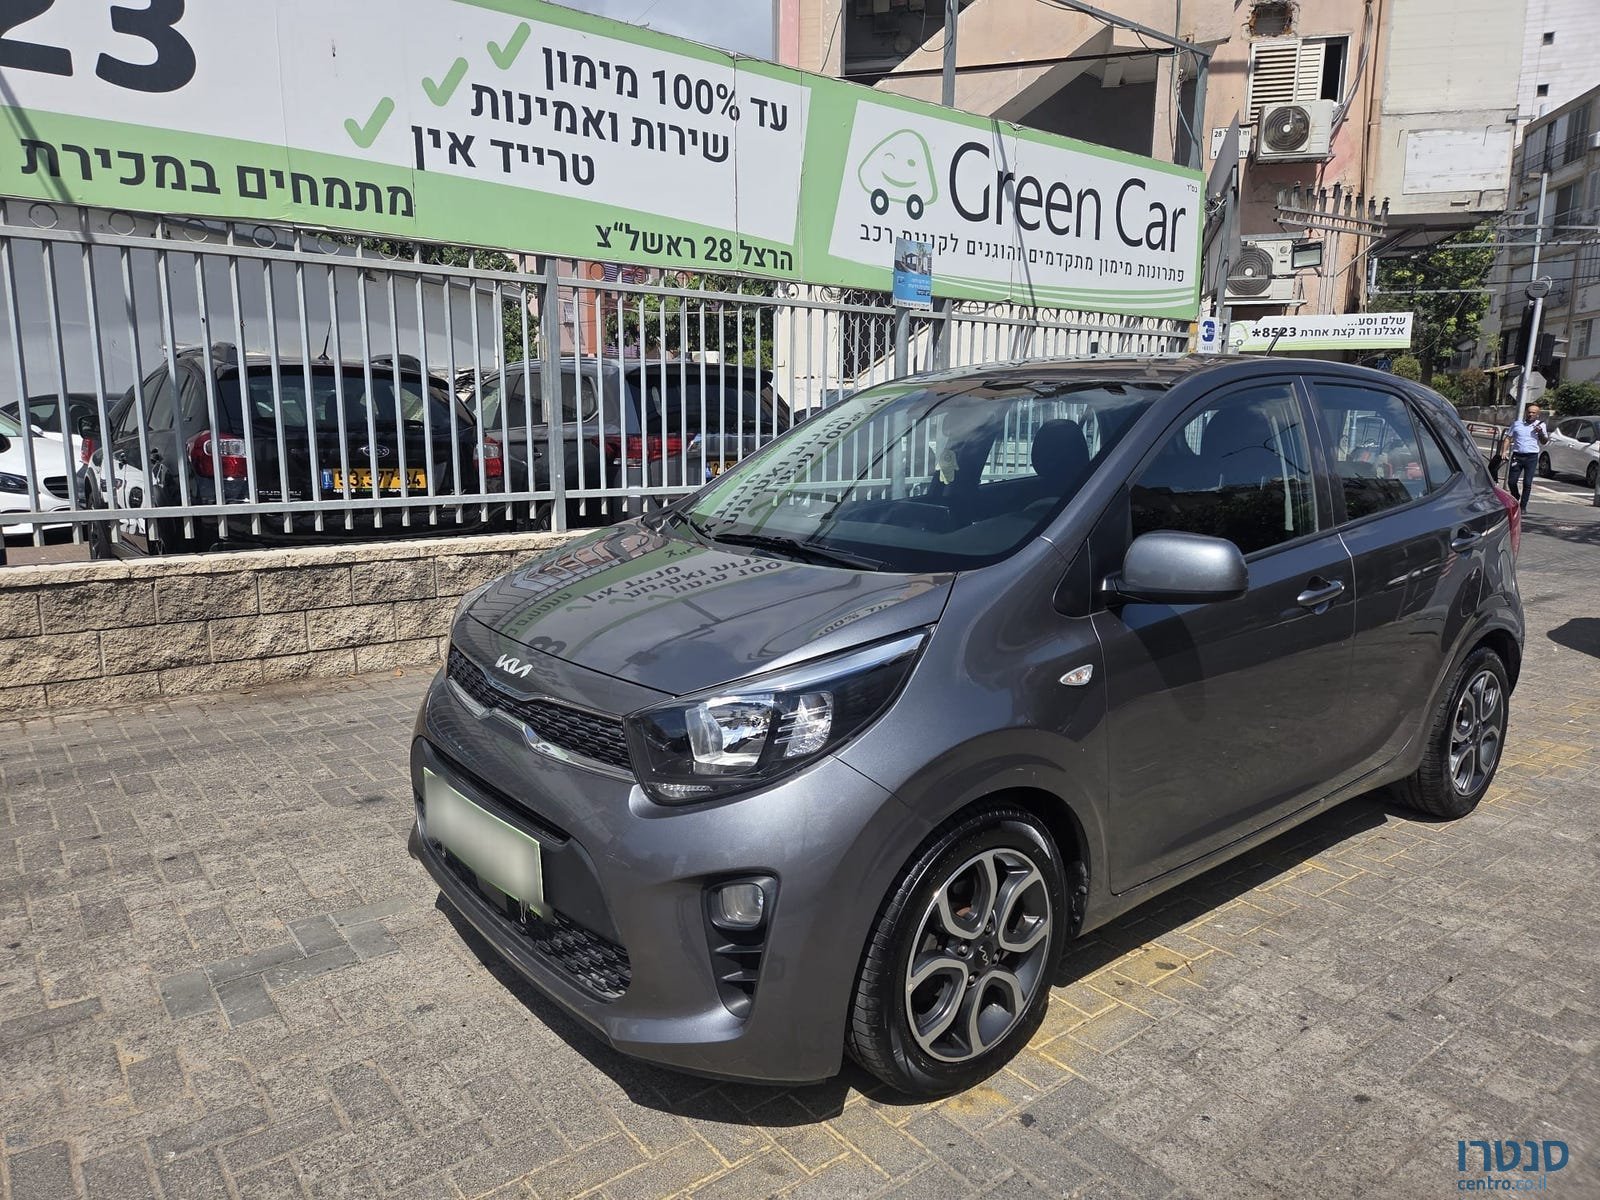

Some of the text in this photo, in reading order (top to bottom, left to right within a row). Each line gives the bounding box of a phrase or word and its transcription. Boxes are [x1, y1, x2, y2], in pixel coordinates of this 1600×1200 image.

[541, 46, 788, 132] עד 100% מימון
[470, 82, 729, 164] שירות ואמינות
[411, 124, 595, 186] טרייד אין
[20, 138, 415, 218] מתמחים במכירת
[948, 141, 1187, 253] Green Car
[860, 223, 893, 244] רכב
[703, 236, 733, 264] 28
[739, 239, 793, 271] הרצל
[966, 239, 1022, 262] והוגנים
[1029, 249, 1093, 272] מתקדמים
[1099, 258, 1132, 277] מימון
[1137, 263, 1185, 283] פתרונות
[1359, 327, 1371, 336] זה
[1375, 326, 1405, 336] אצלנו
[1381, 315, 1406, 325] שלם
[1300, 328, 1329, 337] אחרת
[1332, 327, 1355, 338] קצת
[495, 653, 534, 679] KIA
